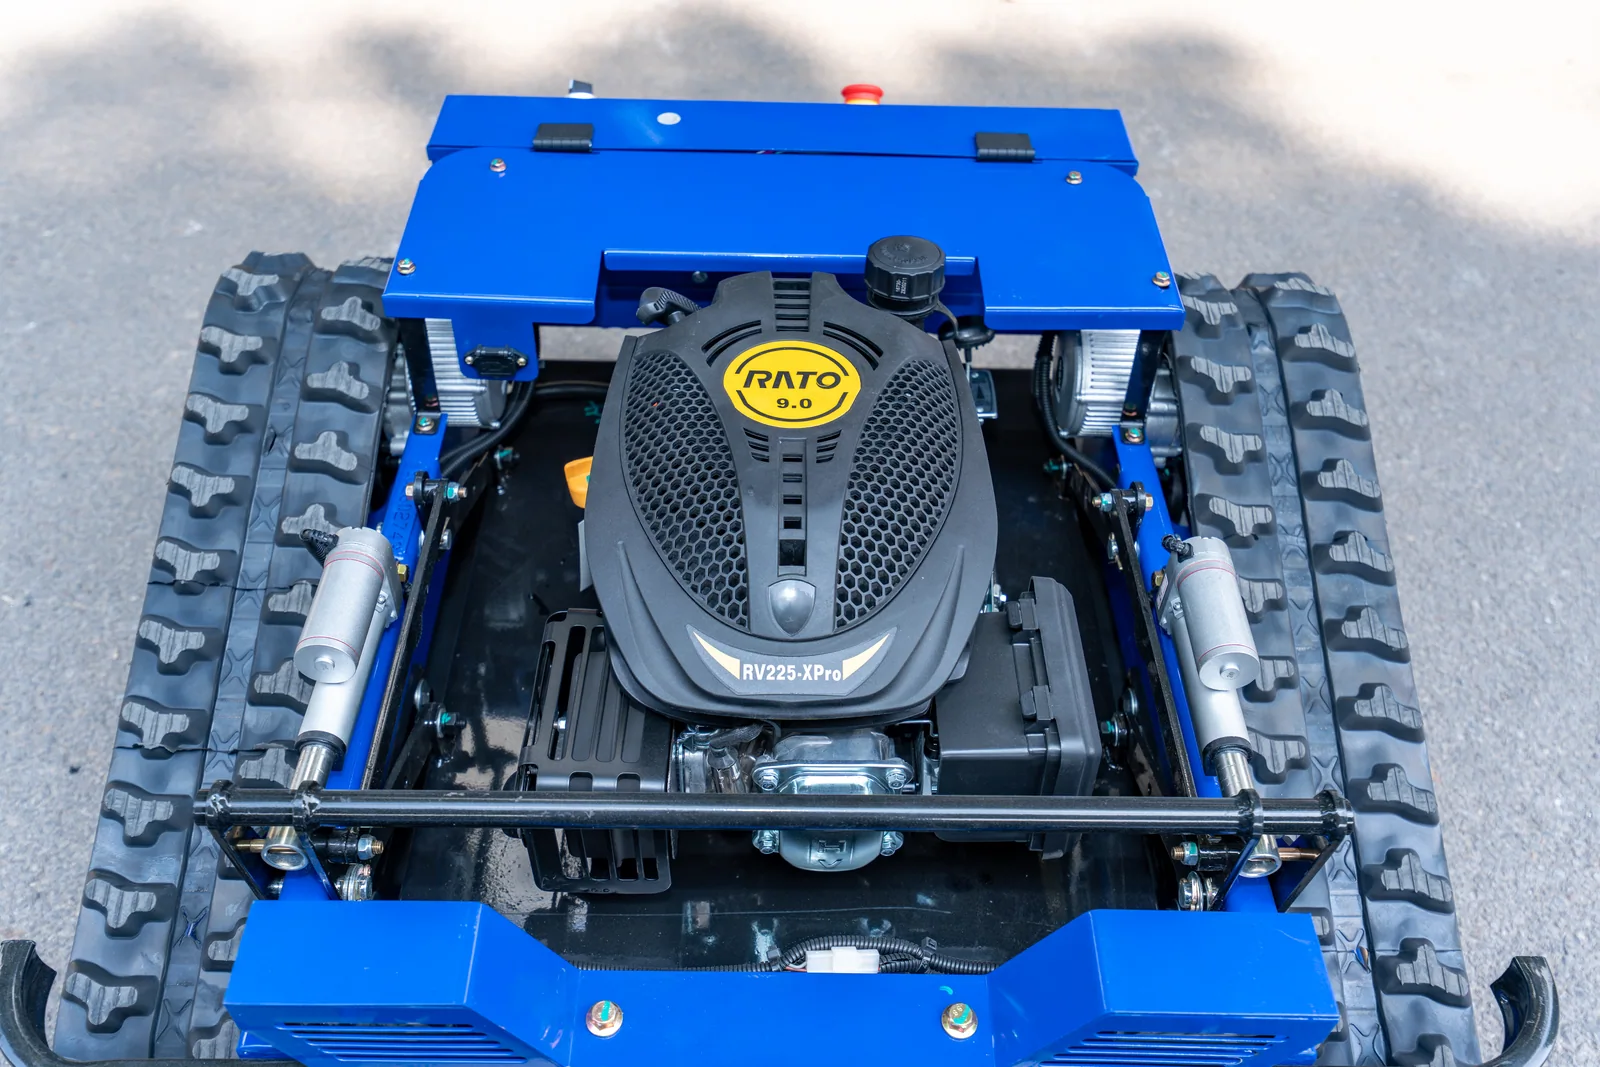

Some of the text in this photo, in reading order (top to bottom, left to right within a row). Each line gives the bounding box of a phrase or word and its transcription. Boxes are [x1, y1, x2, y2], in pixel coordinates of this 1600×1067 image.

[743, 370, 841, 389] RATO
[776, 398, 813, 409] 9.0
[742, 663, 842, 682] RV225-XPro
